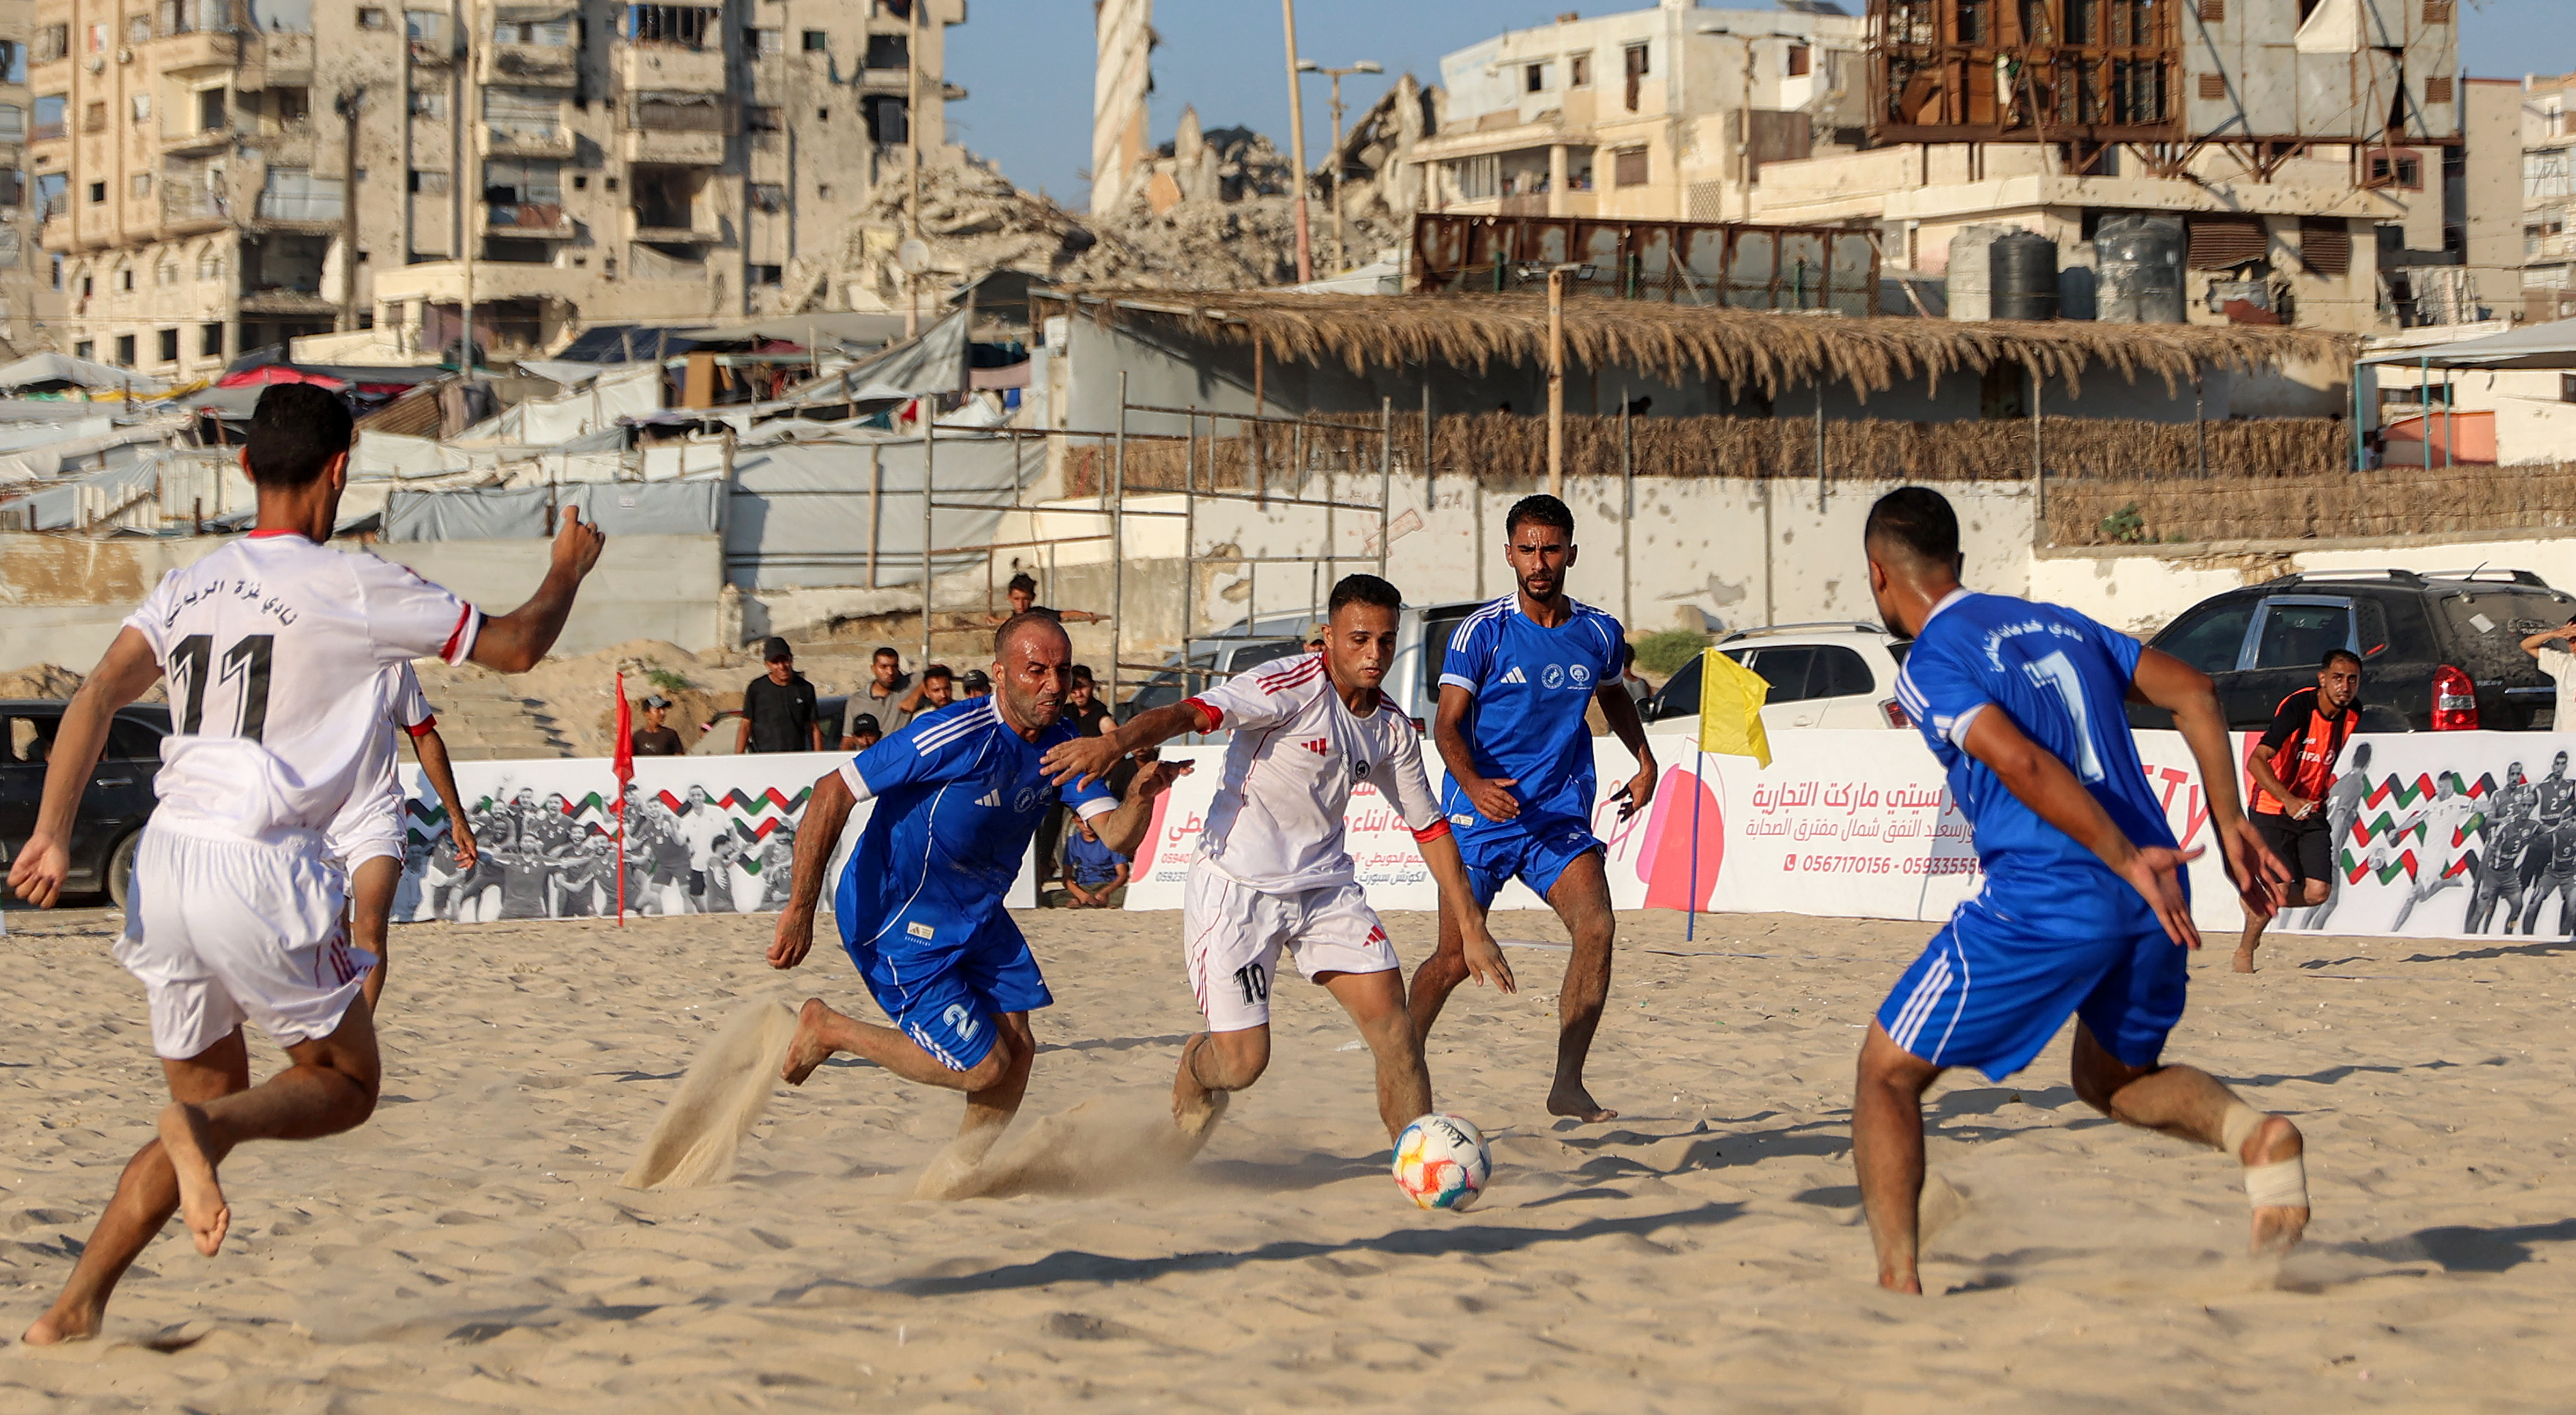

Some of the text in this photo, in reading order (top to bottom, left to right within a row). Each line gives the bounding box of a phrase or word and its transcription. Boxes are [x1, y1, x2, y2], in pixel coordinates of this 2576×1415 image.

[235, 581, 261, 600] غزة
[261, 597, 297, 627] نادي
[169, 634, 275, 744] 11
[2022, 649, 2104, 786] 7
[2296, 751, 2321, 763] FIFA
[1752, 781, 1820, 816] التجارية
[1824, 781, 1879, 816] ماركت
[1885, 783, 1943, 816] سيتي
[2550, 798, 2559, 810] 2
[1351, 804, 1392, 839] أبناء
[1745, 817, 1974, 844] ورسعيد النفق شمال مفترق الصحابة
[1161, 853, 1192, 864] 05940
[1803, 855, 1891, 874] 0567170156
[2563, 847, 2571, 857] 9
[1233, 963, 1267, 1006] 10
[943, 1003, 979, 1042] 2
